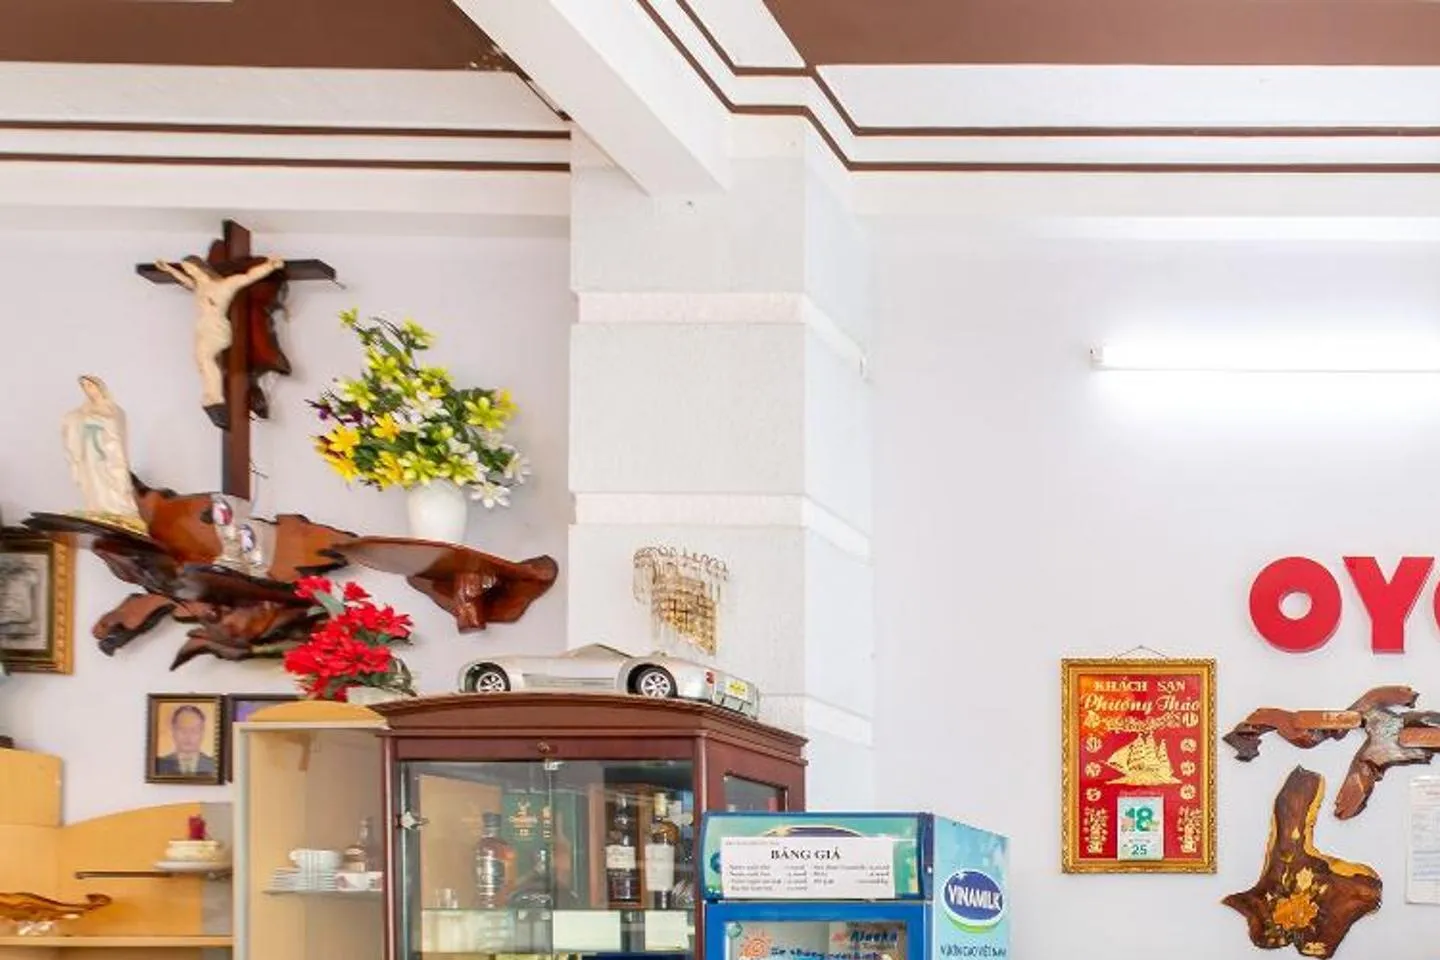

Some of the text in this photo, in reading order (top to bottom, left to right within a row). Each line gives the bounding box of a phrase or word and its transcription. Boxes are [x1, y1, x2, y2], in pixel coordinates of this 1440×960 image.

[1094, 676, 1148, 692] KHÁCH
[1125, 807, 1153, 832] 18
[814, 846, 842, 860] GIÁ
[1131, 844, 1147, 856] 25
[948, 884, 1001, 912] VINAMILK
